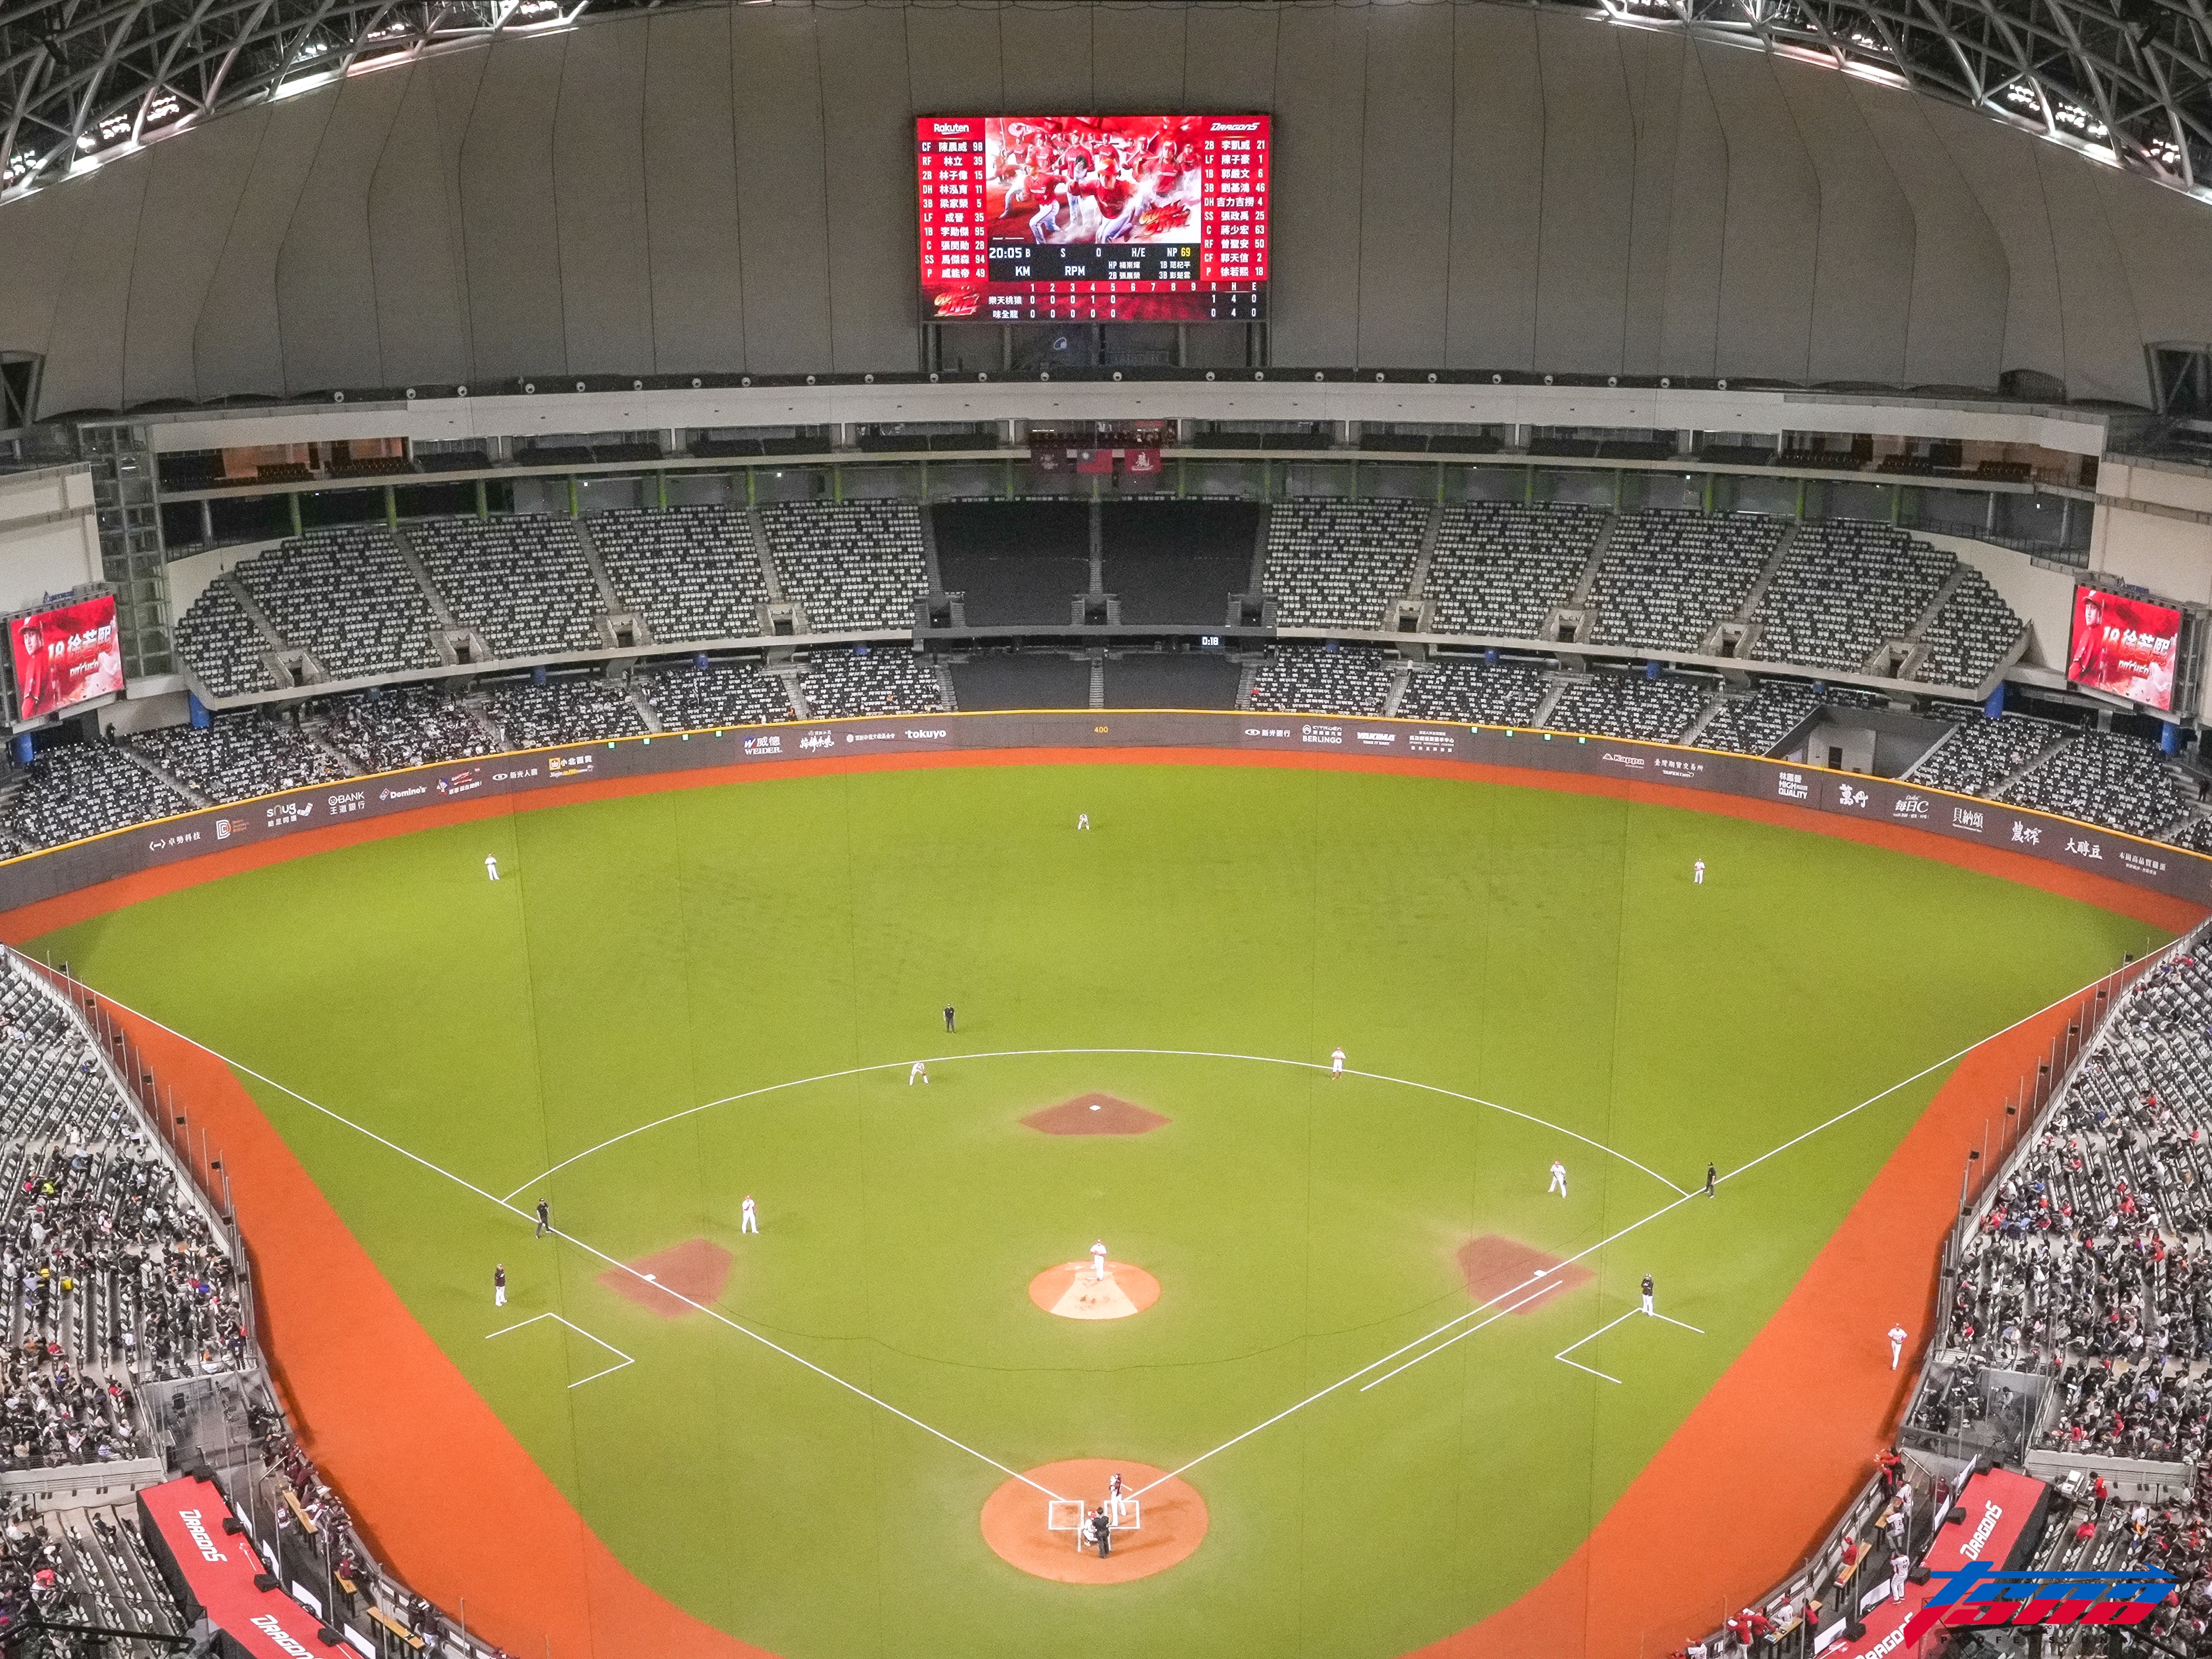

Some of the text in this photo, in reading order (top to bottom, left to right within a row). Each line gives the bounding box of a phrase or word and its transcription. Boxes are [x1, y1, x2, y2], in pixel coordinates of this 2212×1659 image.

[934, 123, 969, 132] Rakuten
[1210, 122, 1260, 131] DRAGONS
[922, 142, 931, 152] CF
[973, 142, 983, 151] 98
[1204, 141, 1214, 150] 2B
[1257, 140, 1265, 149] 21
[922, 156, 983, 166] RF 林立 39
[1205, 155, 1262, 165] LF 陳子豪 1
[922, 170, 932, 180] 2B
[974, 170, 983, 180] 15
[1205, 169, 1214, 178] 1B
[1258, 169, 1263, 178] 6
[923, 185, 982, 194] DH 林泓育 11
[1204, 183, 1214, 193] 3B
[1255, 183, 1265, 192] 46
[923, 199, 933, 209] 3B
[977, 199, 982, 208] 5
[1204, 197, 1214, 206] DH
[1258, 197, 1262, 206] 4
[924, 213, 933, 222] LF
[974, 213, 984, 222] 35
[1204, 211, 1214, 220] SS
[1255, 211, 1265, 220] 25
[924, 227, 933, 236] 1B
[975, 227, 984, 236] 95
[1206, 225, 1211, 234] C
[1255, 225, 1265, 234] 63
[926, 241, 931, 250] C
[975, 241, 985, 250] 28
[1204, 239, 1214, 248] RF
[1255, 239, 1264, 248] 50
[989, 248, 1022, 258] 20:05
[1026, 248, 1030, 258] B
[1060, 248, 1066, 257] S
[1131, 248, 1145, 257] H/E
[1167, 248, 1177, 257] NP
[1181, 247, 1191, 257] 69
[924, 255, 934, 264] SS
[975, 255, 985, 264] 94
[1204, 253, 1262, 263] CF 郭天信 2
[927, 269, 932, 278] P
[975, 269, 985, 278] 49
[1015, 266, 1085, 276] KM RPM
[1159, 271, 1168, 279] 3B
[1206, 267, 1264, 276] P 徐若熙 18
[1030, 282, 1257, 292] 1 2 3 4 5 6 7 8 9 R H E
[1030, 296, 1035, 304] 0
[1050, 296, 1055, 304] 0
[1070, 296, 1076, 304] 0
[1091, 295, 1095, 303] 1
[1111, 295, 1115, 303] 0
[1212, 295, 1216, 303] 1
[1231, 295, 1237, 303] 4
[1251, 294, 1257, 303] 0
[992, 308, 1256, 319] 味全龍 0 0 0 0 0 0 4 0
[1202, 637, 1218, 645] 0:18
[2102, 626, 2121, 650] 18
[47, 640, 65, 663] 18
[907, 730, 947, 739] tokuyo
[1357, 732, 1395, 741] YAKIMA
[1302, 736, 1342, 744] BERLINGO
[1614, 754, 1644, 765] Kappa
[1779, 780, 1797, 790] HIGH
[390, 786, 427, 799] Domino's
[1779, 788, 1808, 800] QUALITY
[1895, 800, 1929, 813] 每日C
[179, 1509, 228, 1562] DRAGONS
[1960, 1500, 2002, 1561] DRAGONS
[250, 1614, 324, 1659] DRAGON
